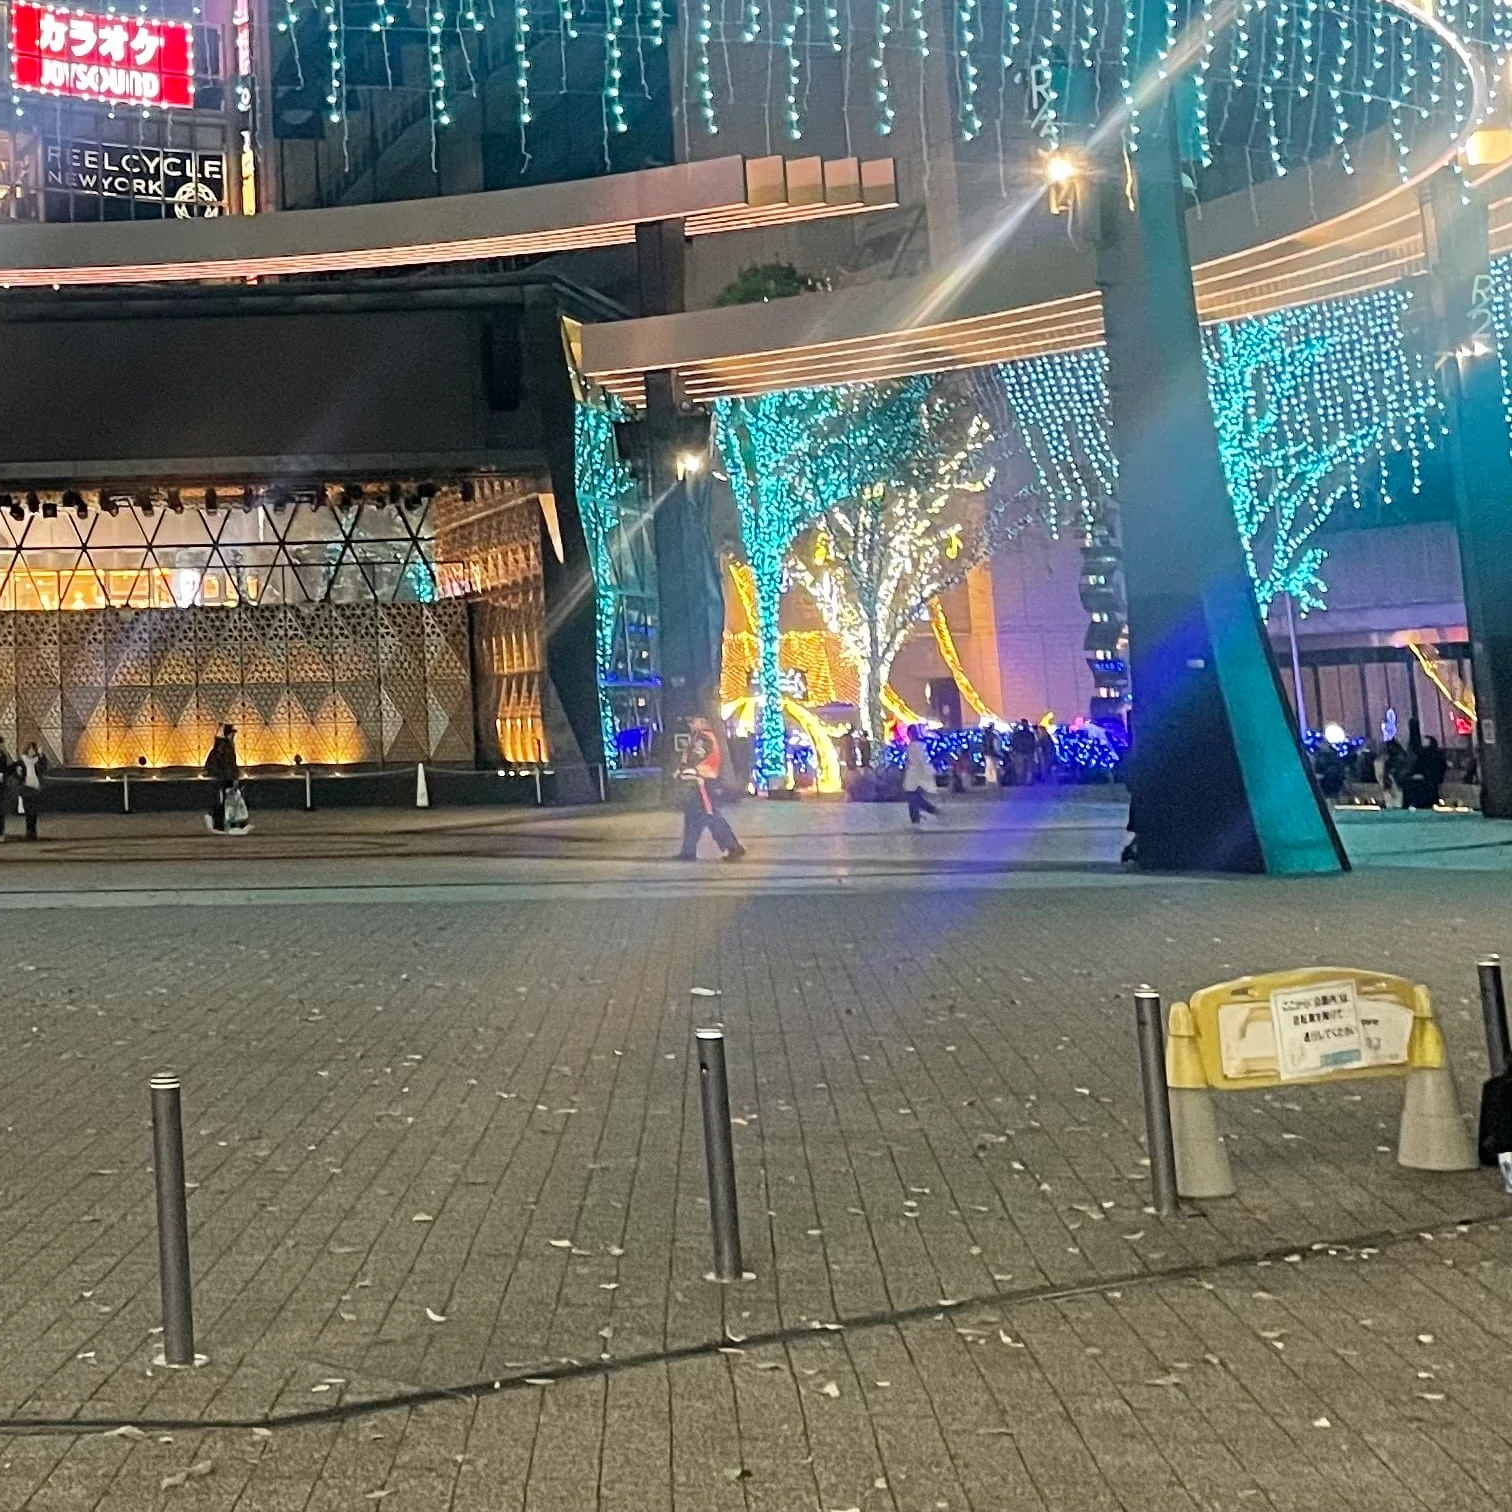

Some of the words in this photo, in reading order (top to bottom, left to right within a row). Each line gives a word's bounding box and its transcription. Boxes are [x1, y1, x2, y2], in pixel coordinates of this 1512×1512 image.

[39, 13, 161, 66] カラオケ
[40, 58, 160, 98] JOYSOUND
